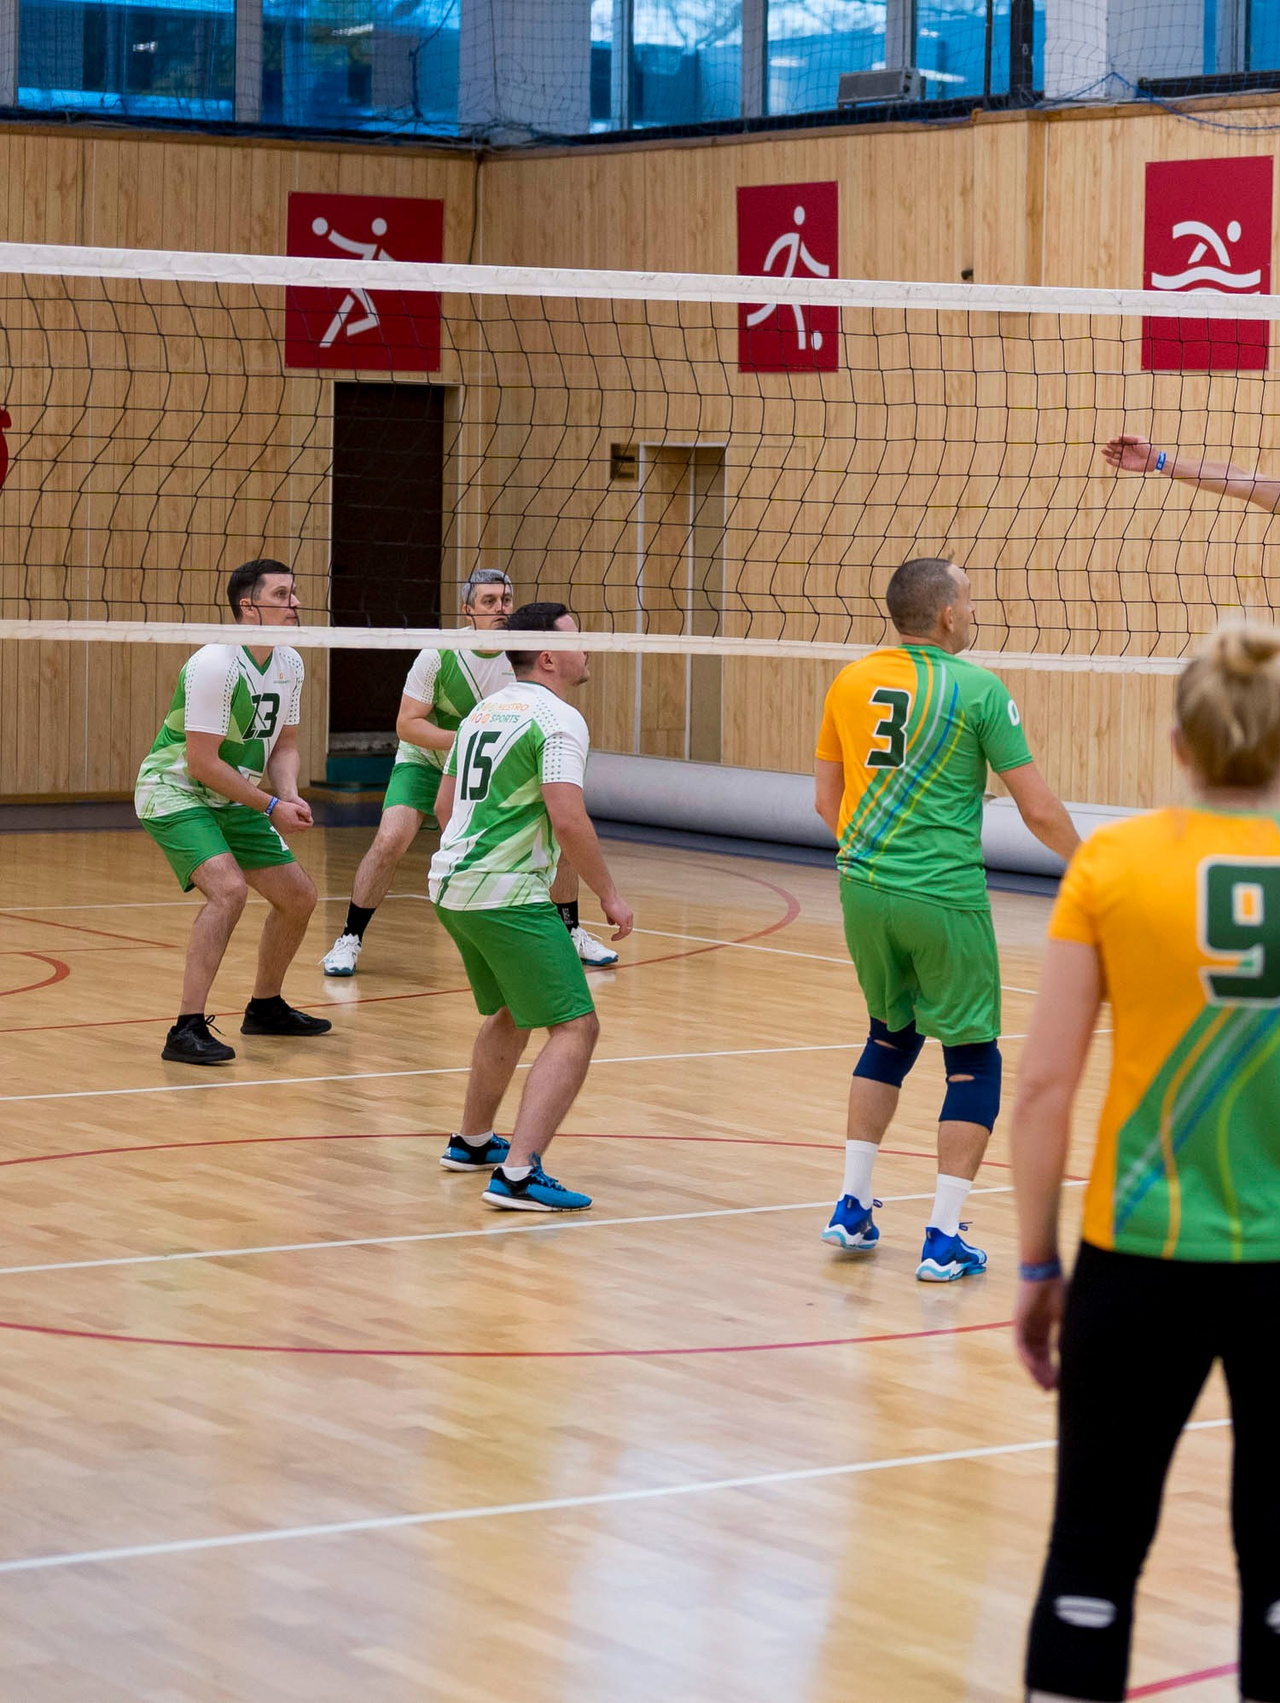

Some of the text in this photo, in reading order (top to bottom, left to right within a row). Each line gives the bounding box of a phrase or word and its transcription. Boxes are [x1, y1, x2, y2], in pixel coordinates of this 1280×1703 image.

[490, 713, 521, 723] SPORTS
[865, 687, 911, 768] 3
[460, 730, 502, 801] 15
